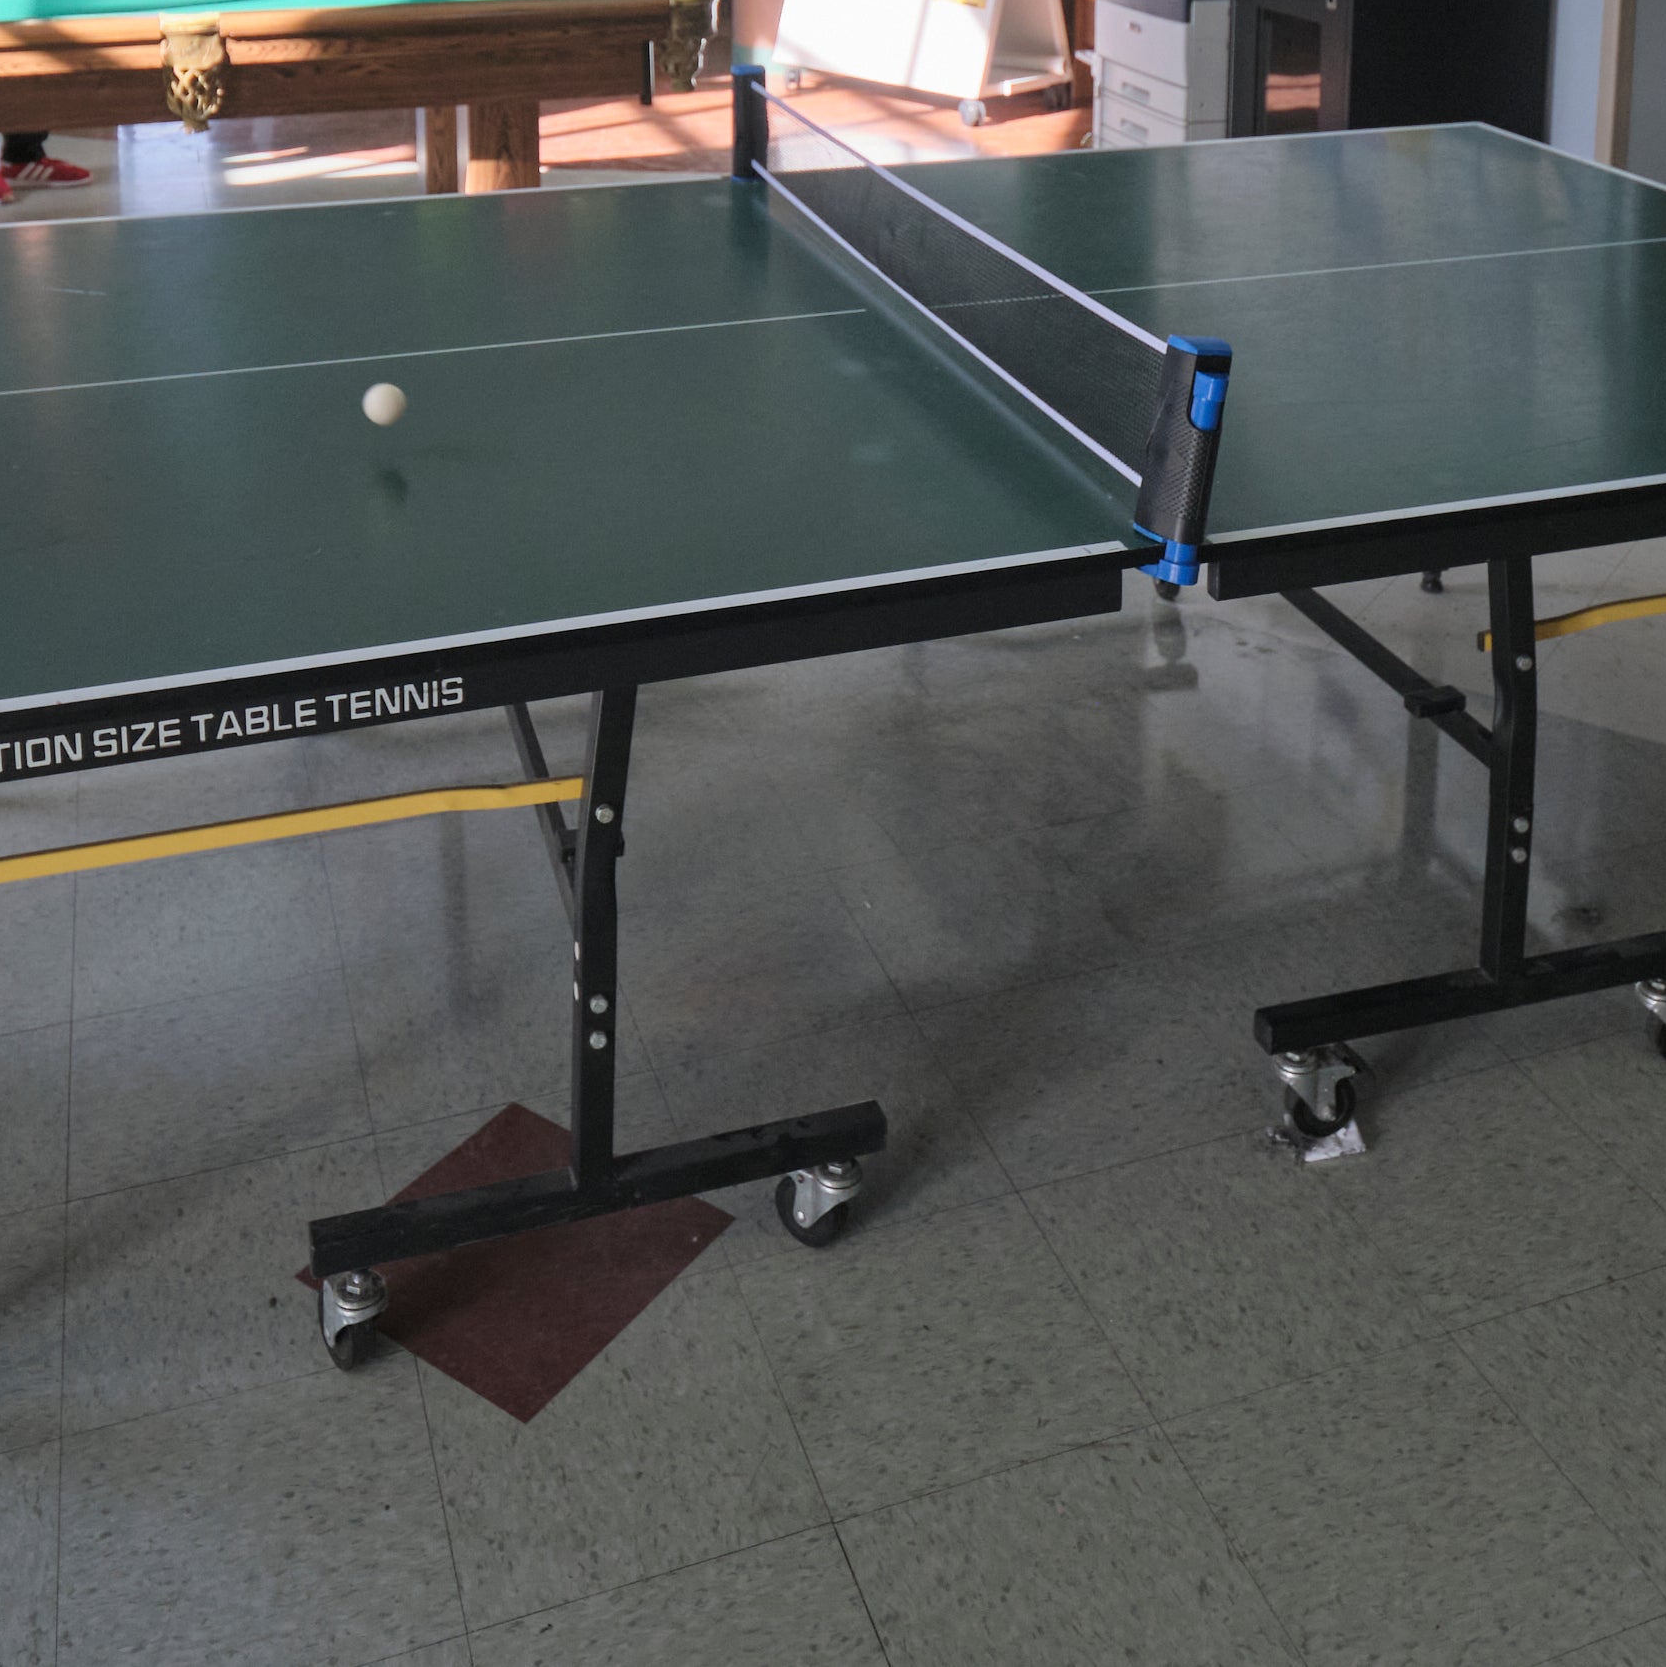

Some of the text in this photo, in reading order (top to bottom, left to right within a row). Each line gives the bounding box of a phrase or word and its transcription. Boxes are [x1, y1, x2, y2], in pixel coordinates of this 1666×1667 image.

[93, 718, 182, 758] SIZE
[191, 698, 317, 742] TABLE
[325, 677, 463, 723] TENNIS
